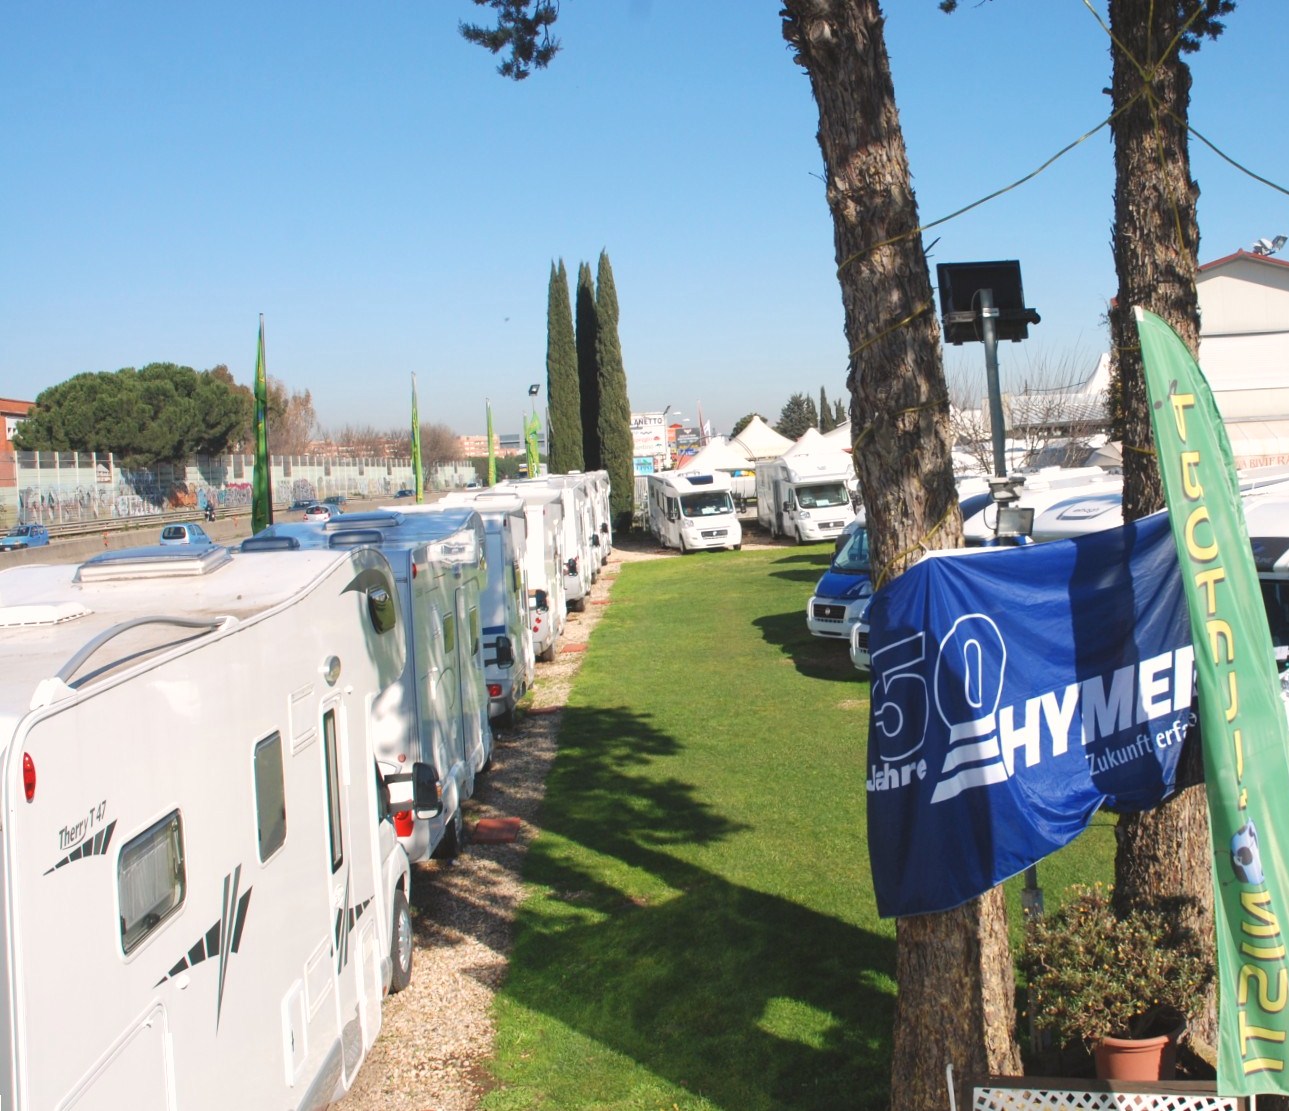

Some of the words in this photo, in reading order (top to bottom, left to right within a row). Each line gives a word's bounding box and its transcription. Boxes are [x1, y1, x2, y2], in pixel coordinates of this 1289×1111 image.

[866, 759, 927, 791] Jahre
[1085, 734, 1153, 777] Zukunft
[59, 817, 88, 850] Therry
[96, 800, 107, 821] 47
